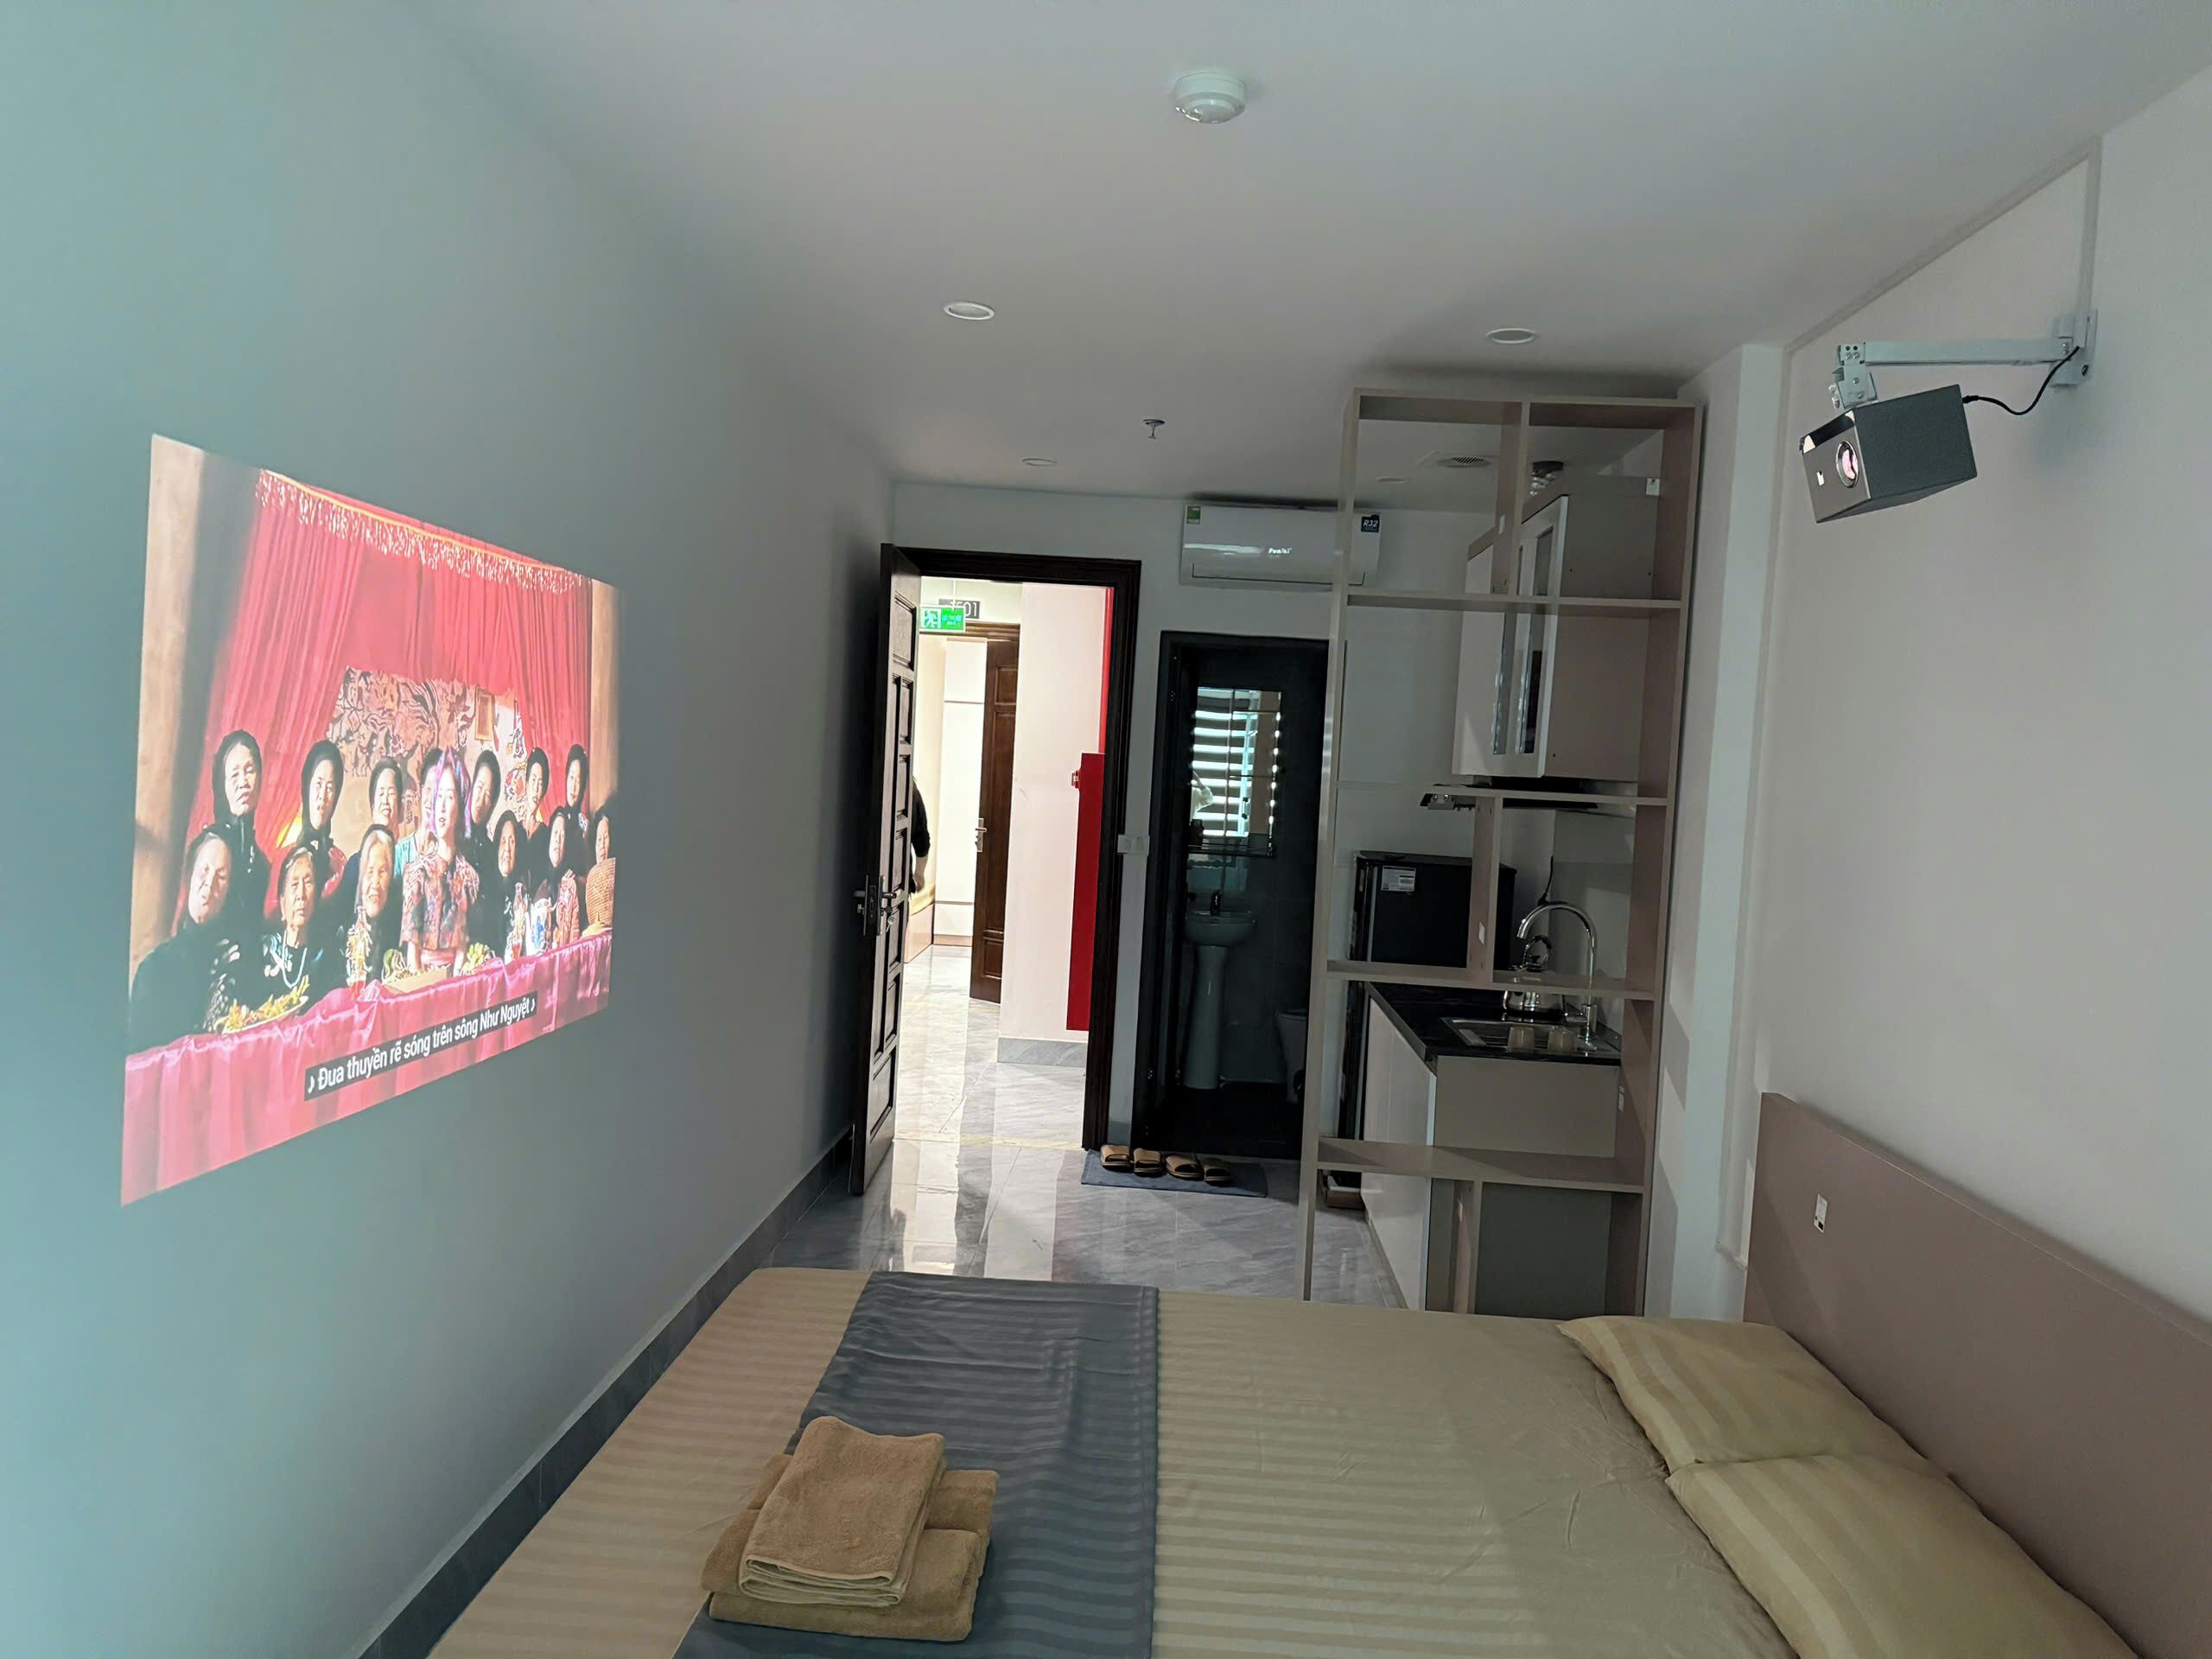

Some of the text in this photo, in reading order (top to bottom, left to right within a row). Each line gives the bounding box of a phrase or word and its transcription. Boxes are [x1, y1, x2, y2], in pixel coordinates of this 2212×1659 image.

[317, 997, 531, 1090] Đua thuyền rẽ sóng trên sông Như Nguyệt
